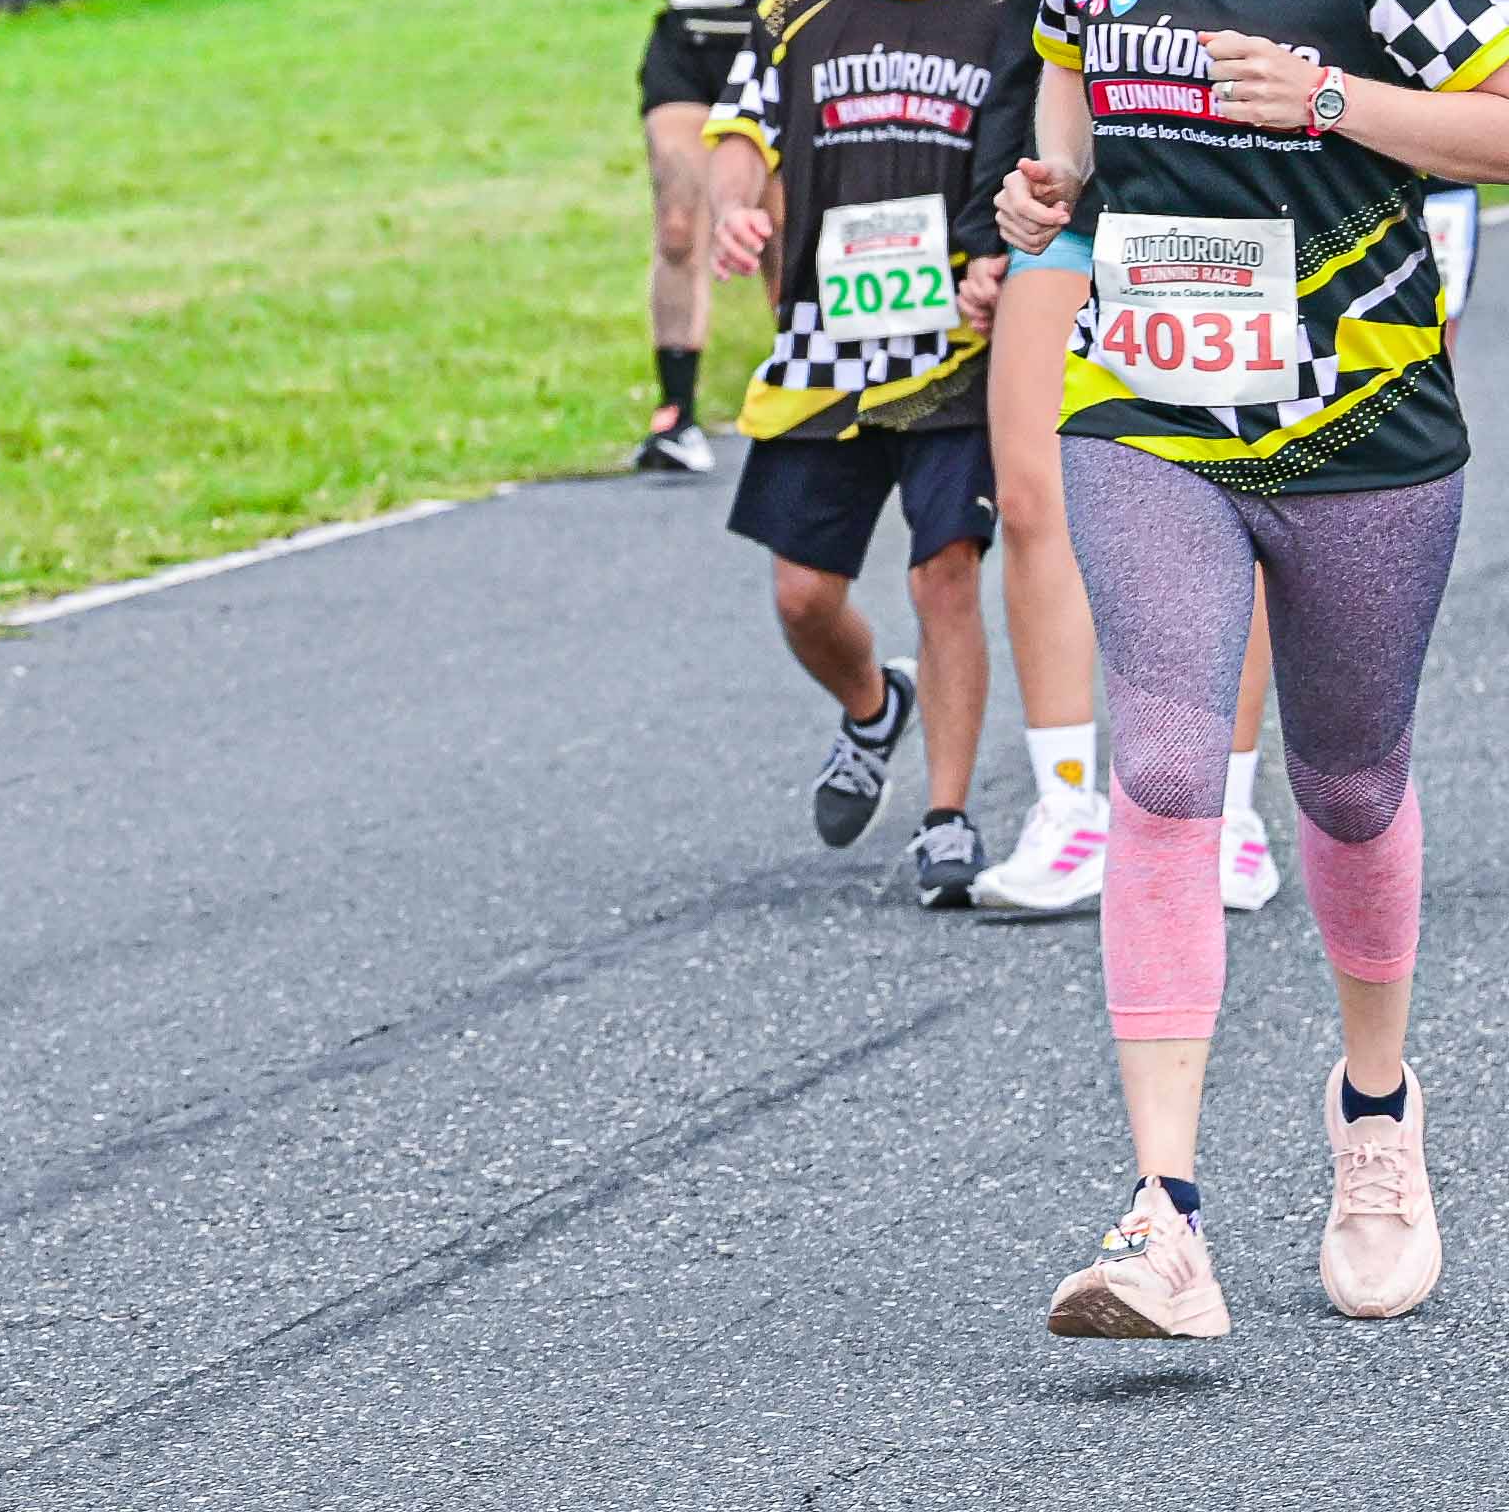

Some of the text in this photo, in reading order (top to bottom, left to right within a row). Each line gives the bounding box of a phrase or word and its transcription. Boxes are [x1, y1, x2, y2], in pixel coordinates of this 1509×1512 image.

[812, 43, 992, 107] AUTÓDROMO
[1105, 84, 1204, 114] RUNNING
[1137, 123, 1158, 138] de
[1159, 125, 1181, 140] los
[1182, 127, 1227, 148] Clubes
[1228, 133, 1253, 149] del
[1121, 228, 1264, 267] AUTÓDROMO
[825, 266, 948, 317] 2022
[1202, 268, 1238, 284] RACE
[1102, 309, 1286, 373] 4031
